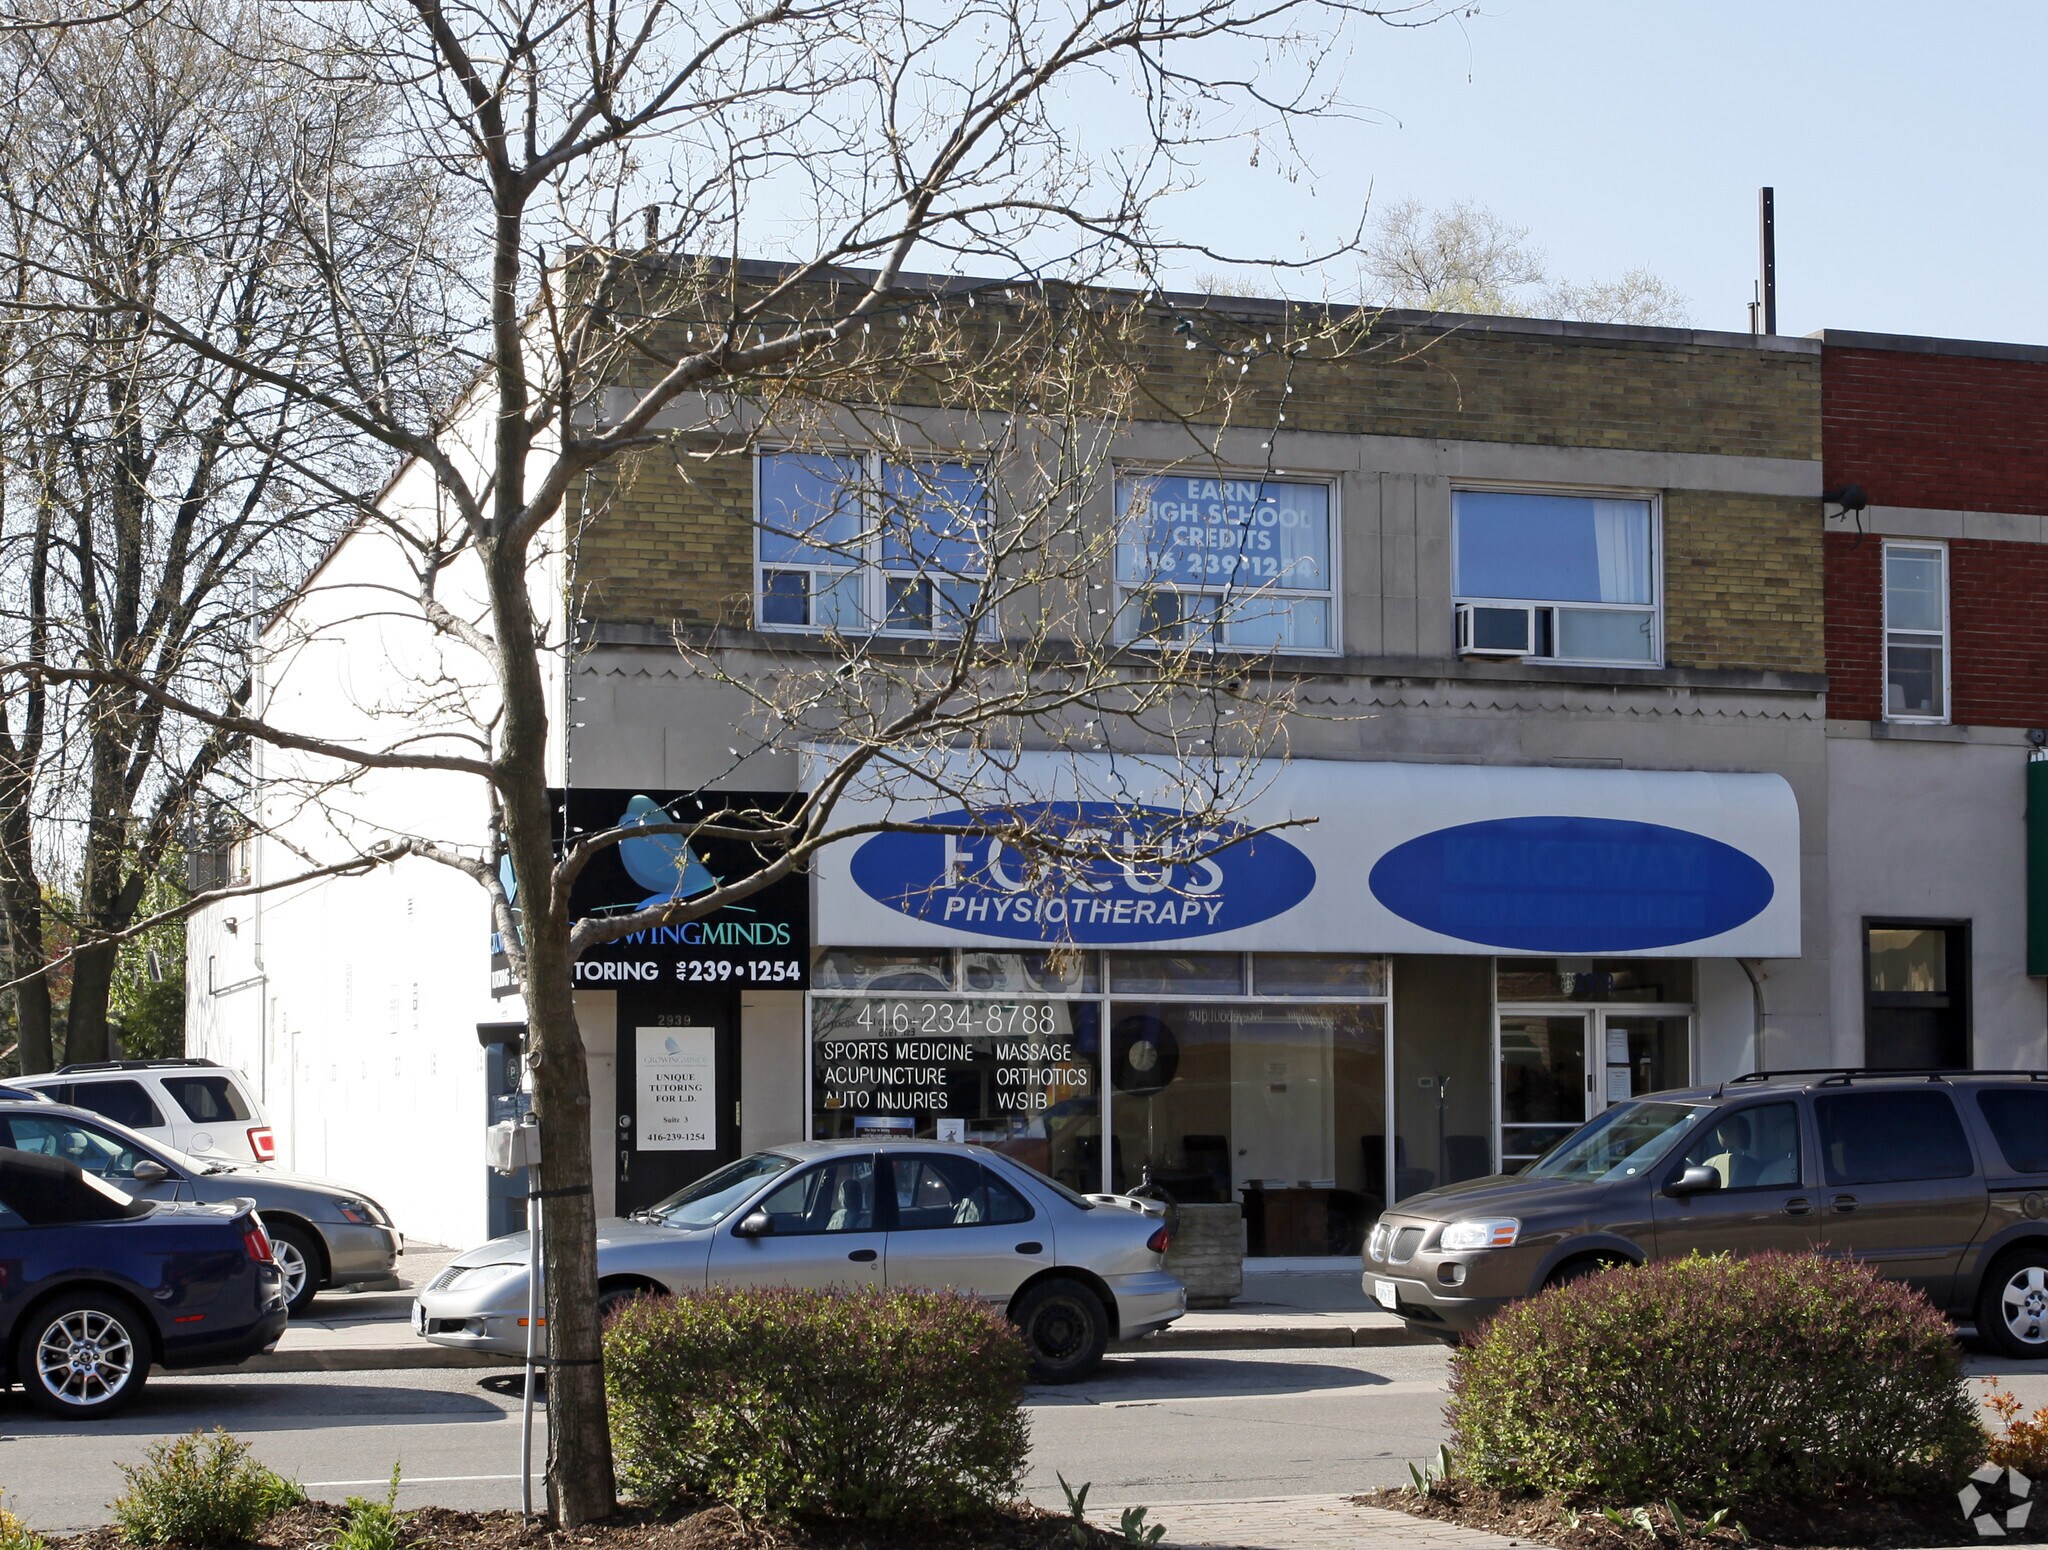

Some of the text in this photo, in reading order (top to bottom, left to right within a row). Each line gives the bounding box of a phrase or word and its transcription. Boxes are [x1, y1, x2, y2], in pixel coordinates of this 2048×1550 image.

[1187, 480, 1257, 502] EARN
[1146, 502, 1312, 528] IGH SCHOOL
[1173, 526, 1271, 550] CREDITS
[944, 828, 1224, 894] FOCUS
[943, 896, 1224, 926] PHYSIOTHERAPY
[573, 961, 659, 981] TORING
[658, 1014, 692, 1026] 2939
[857, 1004, 1056, 1034] 416-234-8788
[824, 1041, 974, 1061] SPORTS MEDICINE
[996, 1043, 1072, 1061] MASSAGE
[656, 1073, 696, 1083] UNIQUE
[824, 1066, 947, 1085] ACUPUNCTURE
[996, 1067, 1088, 1086] ORTHOTICS
[649, 1084, 703, 1093] TUTORING
[656, 1095, 697, 1103] FOR L.D.
[877, 1091, 949, 1110] INJURIES
[997, 1091, 1048, 1110] WSIB
[663, 1116, 689, 1124] Suite 3
[647, 1133, 706, 1142] 416-239-1254
